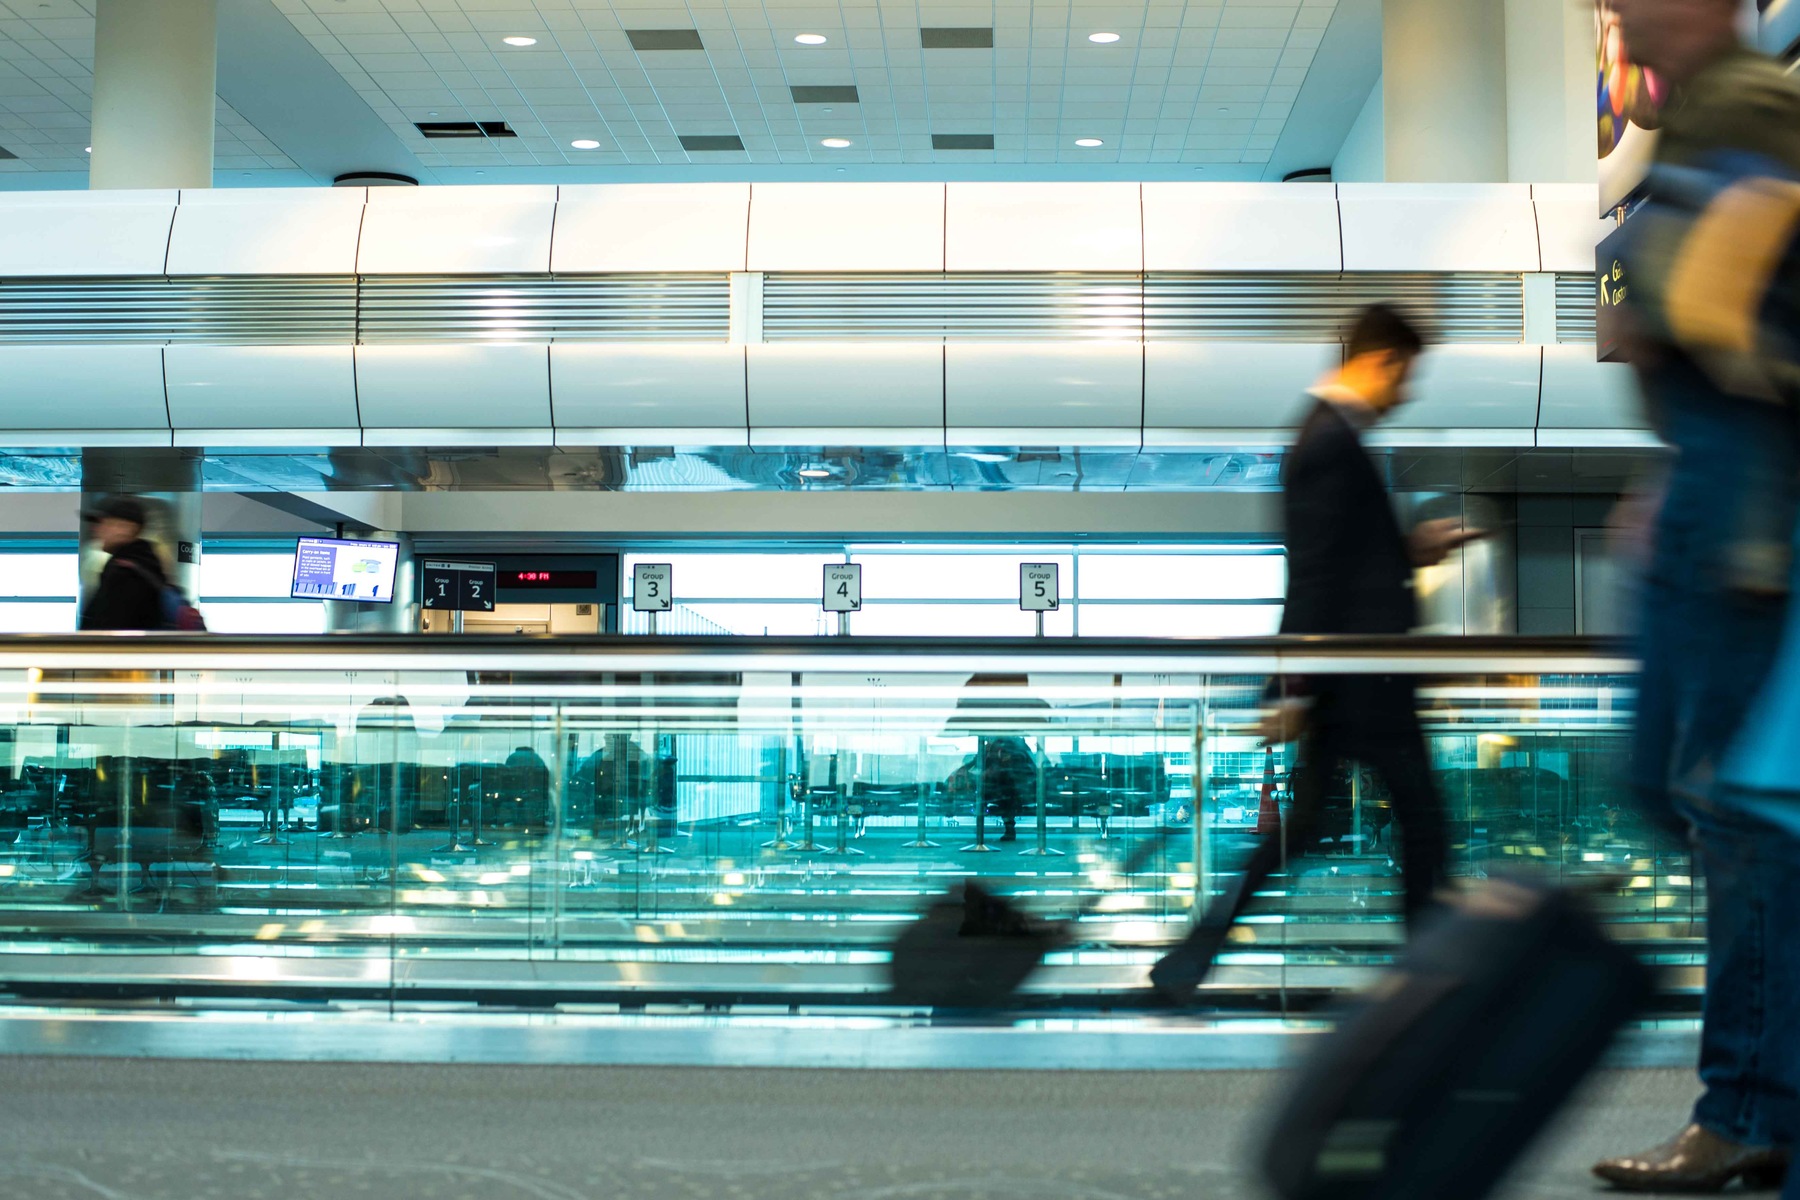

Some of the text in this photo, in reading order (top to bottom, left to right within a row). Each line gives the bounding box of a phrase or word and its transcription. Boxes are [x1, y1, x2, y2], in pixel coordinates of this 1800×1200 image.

[539, 572, 550, 581] PM
[642, 572, 664, 581] Group
[831, 572, 854, 581] Group
[1028, 571, 1051, 580] Group
[438, 583, 446, 597] 1
[471, 585, 481, 598] 2
[647, 581, 659, 598] 3
[836, 581, 849, 598] 4
[1034, 580, 1046, 597] 5
